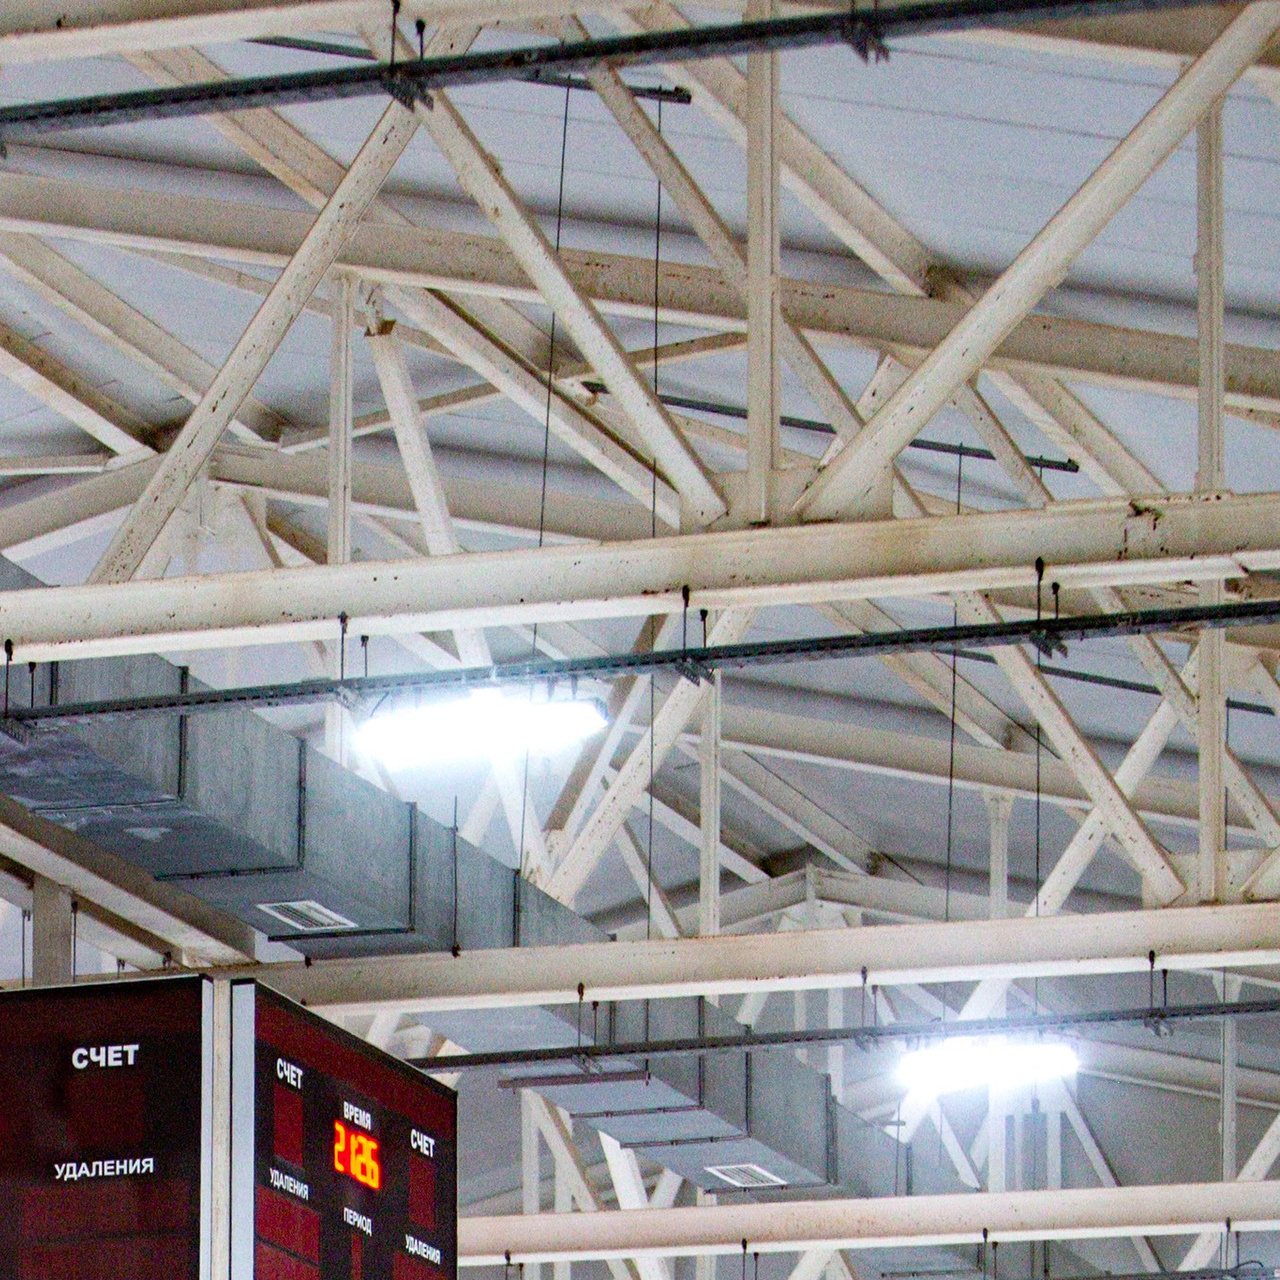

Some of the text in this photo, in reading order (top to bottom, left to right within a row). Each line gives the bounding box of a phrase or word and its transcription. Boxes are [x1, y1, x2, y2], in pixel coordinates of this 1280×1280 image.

[73, 1044, 140, 1069] СЧЕТ
[276, 1057, 304, 1090] СЧЕТ
[343, 1101, 372, 1131] ВРЕМЯ
[410, 1128, 435, 1158] СЧЕТ
[54, 1158, 154, 1181] УДАЛЕНИЯ
[269, 1167, 309, 1200] УДАЛЕНИЯ
[343, 1206, 373, 1237] ПЕРИОД
[405, 1234, 441, 1265] УДАЛЕНИЯ
